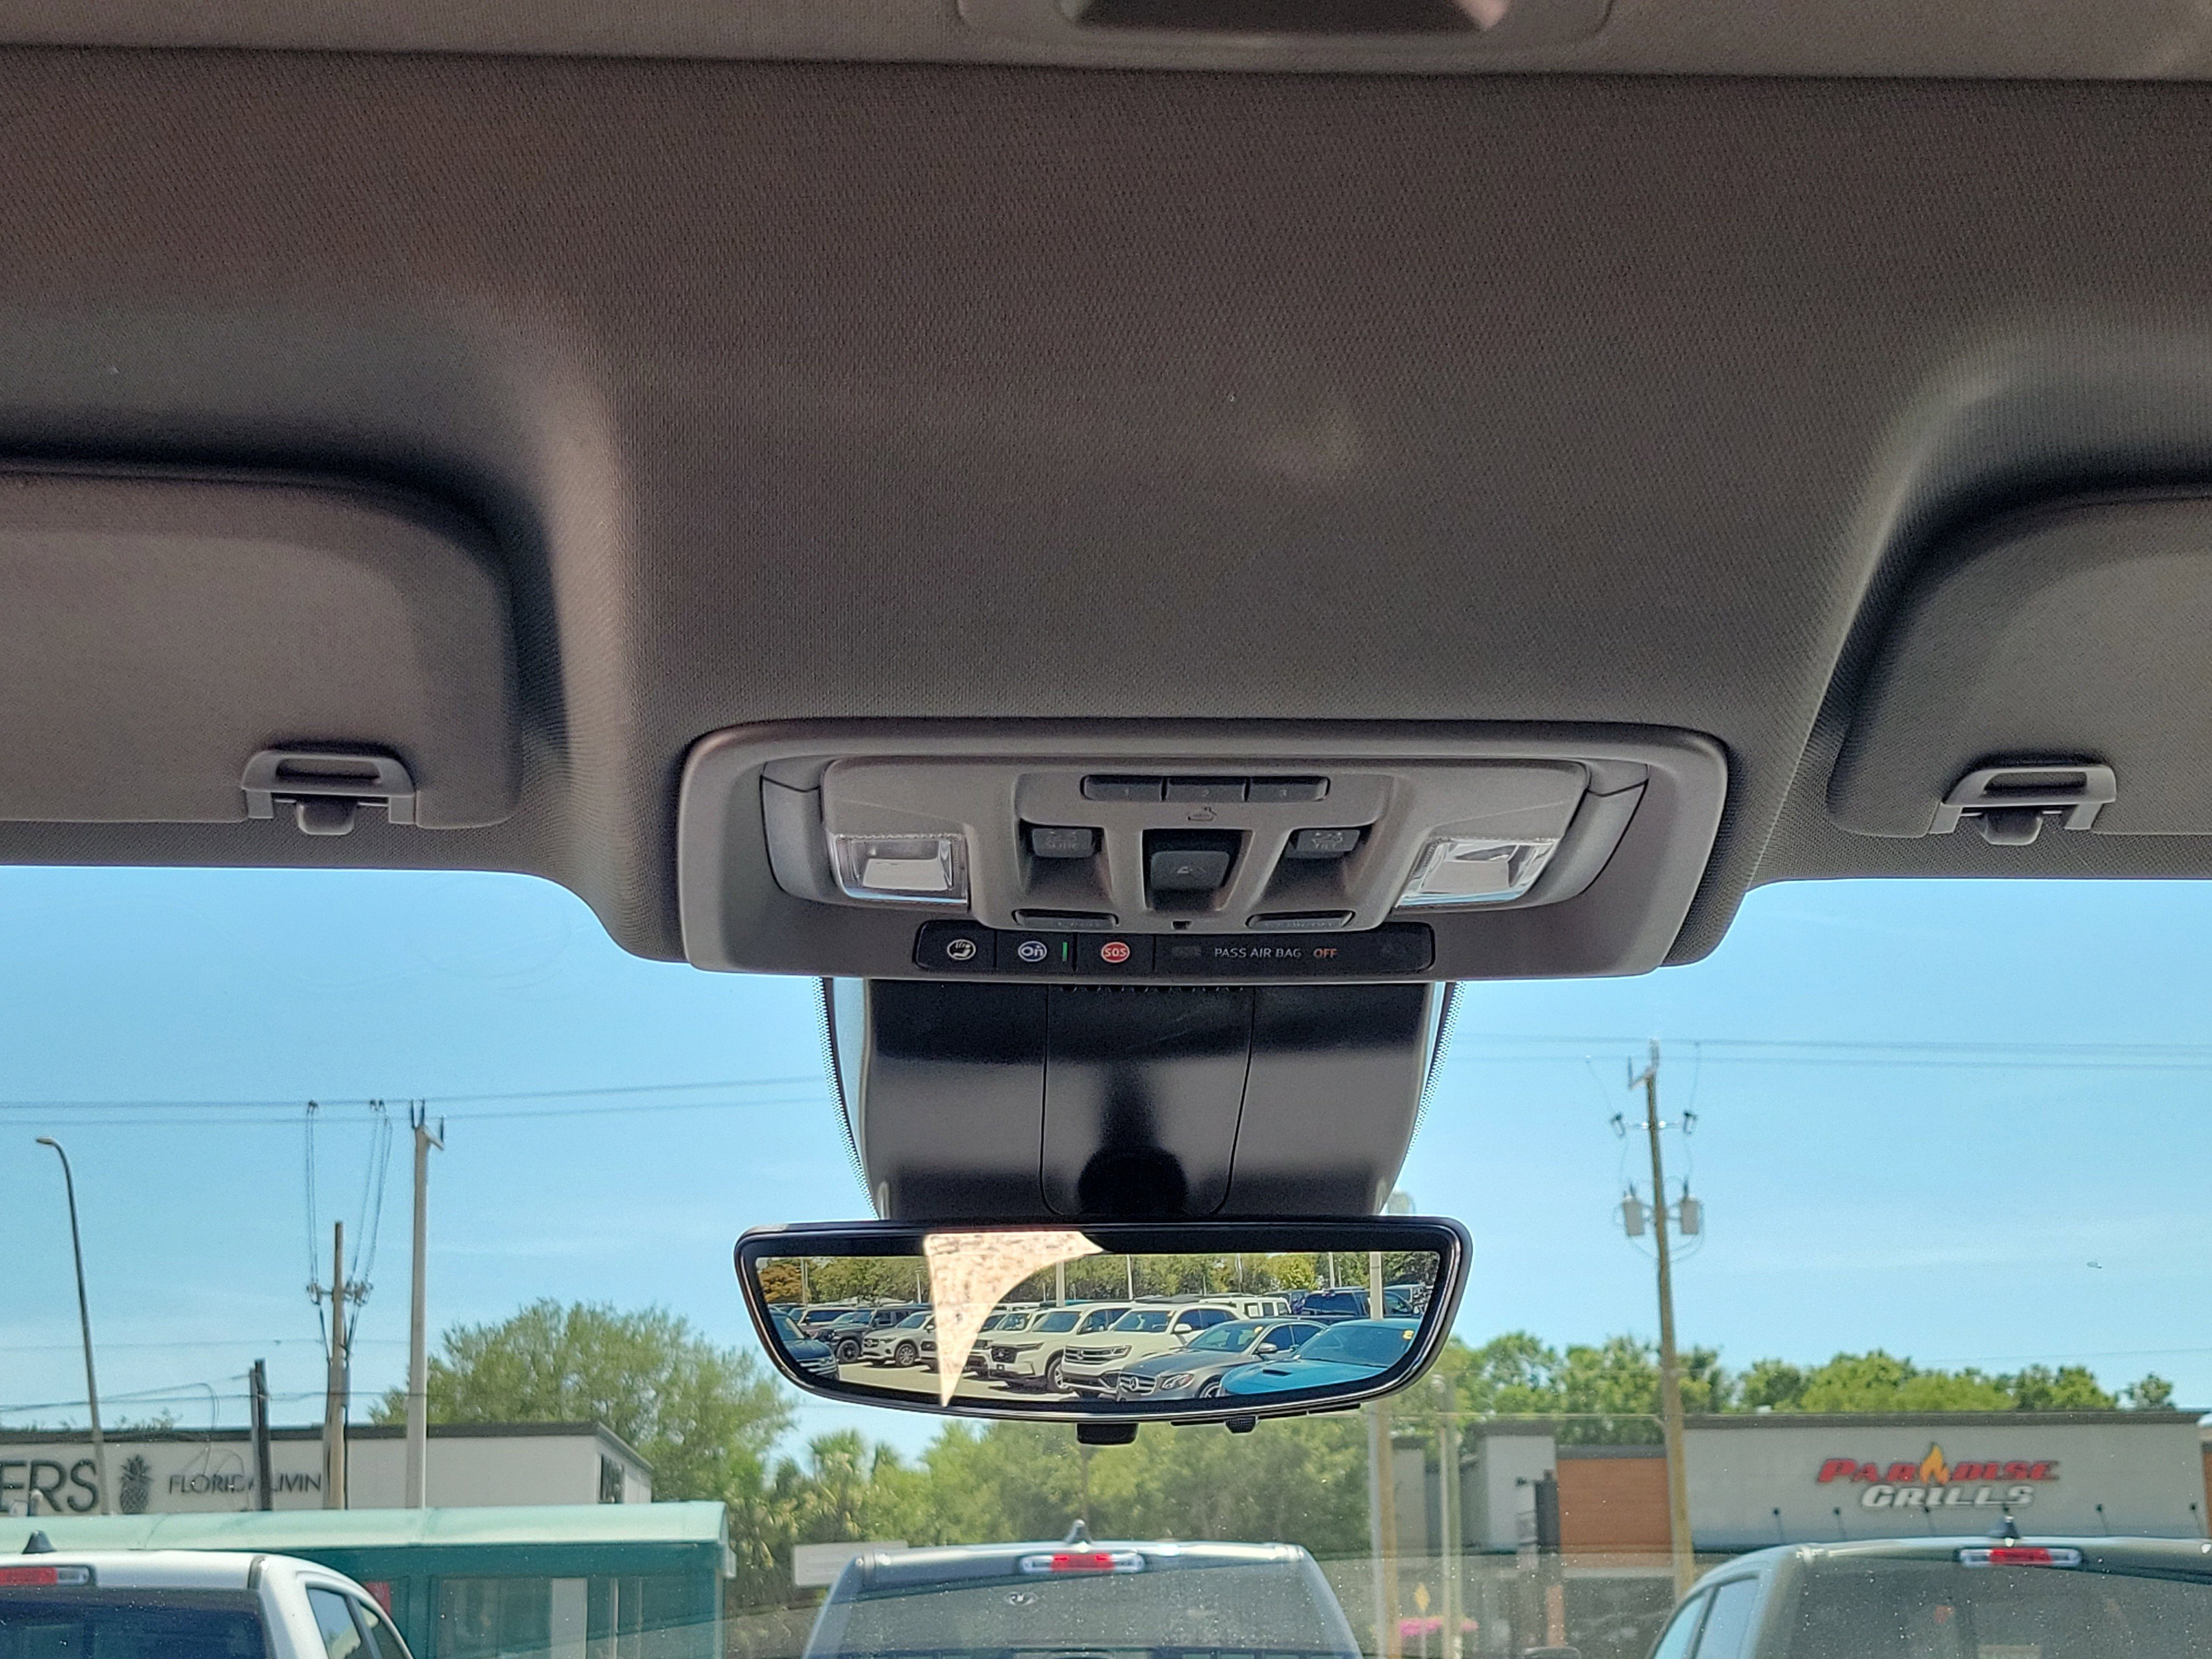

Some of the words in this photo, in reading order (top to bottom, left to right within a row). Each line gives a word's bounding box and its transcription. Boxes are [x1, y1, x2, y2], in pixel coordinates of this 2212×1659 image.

[1104, 947, 1127, 957] SOS
[1214, 947, 1247, 958] PASS
[1250, 948, 1272, 958] AIR
[1276, 948, 1302, 958] BAG
[1313, 948, 1338, 958] OFF
[1861, 1483, 2034, 1509] GRILLS
